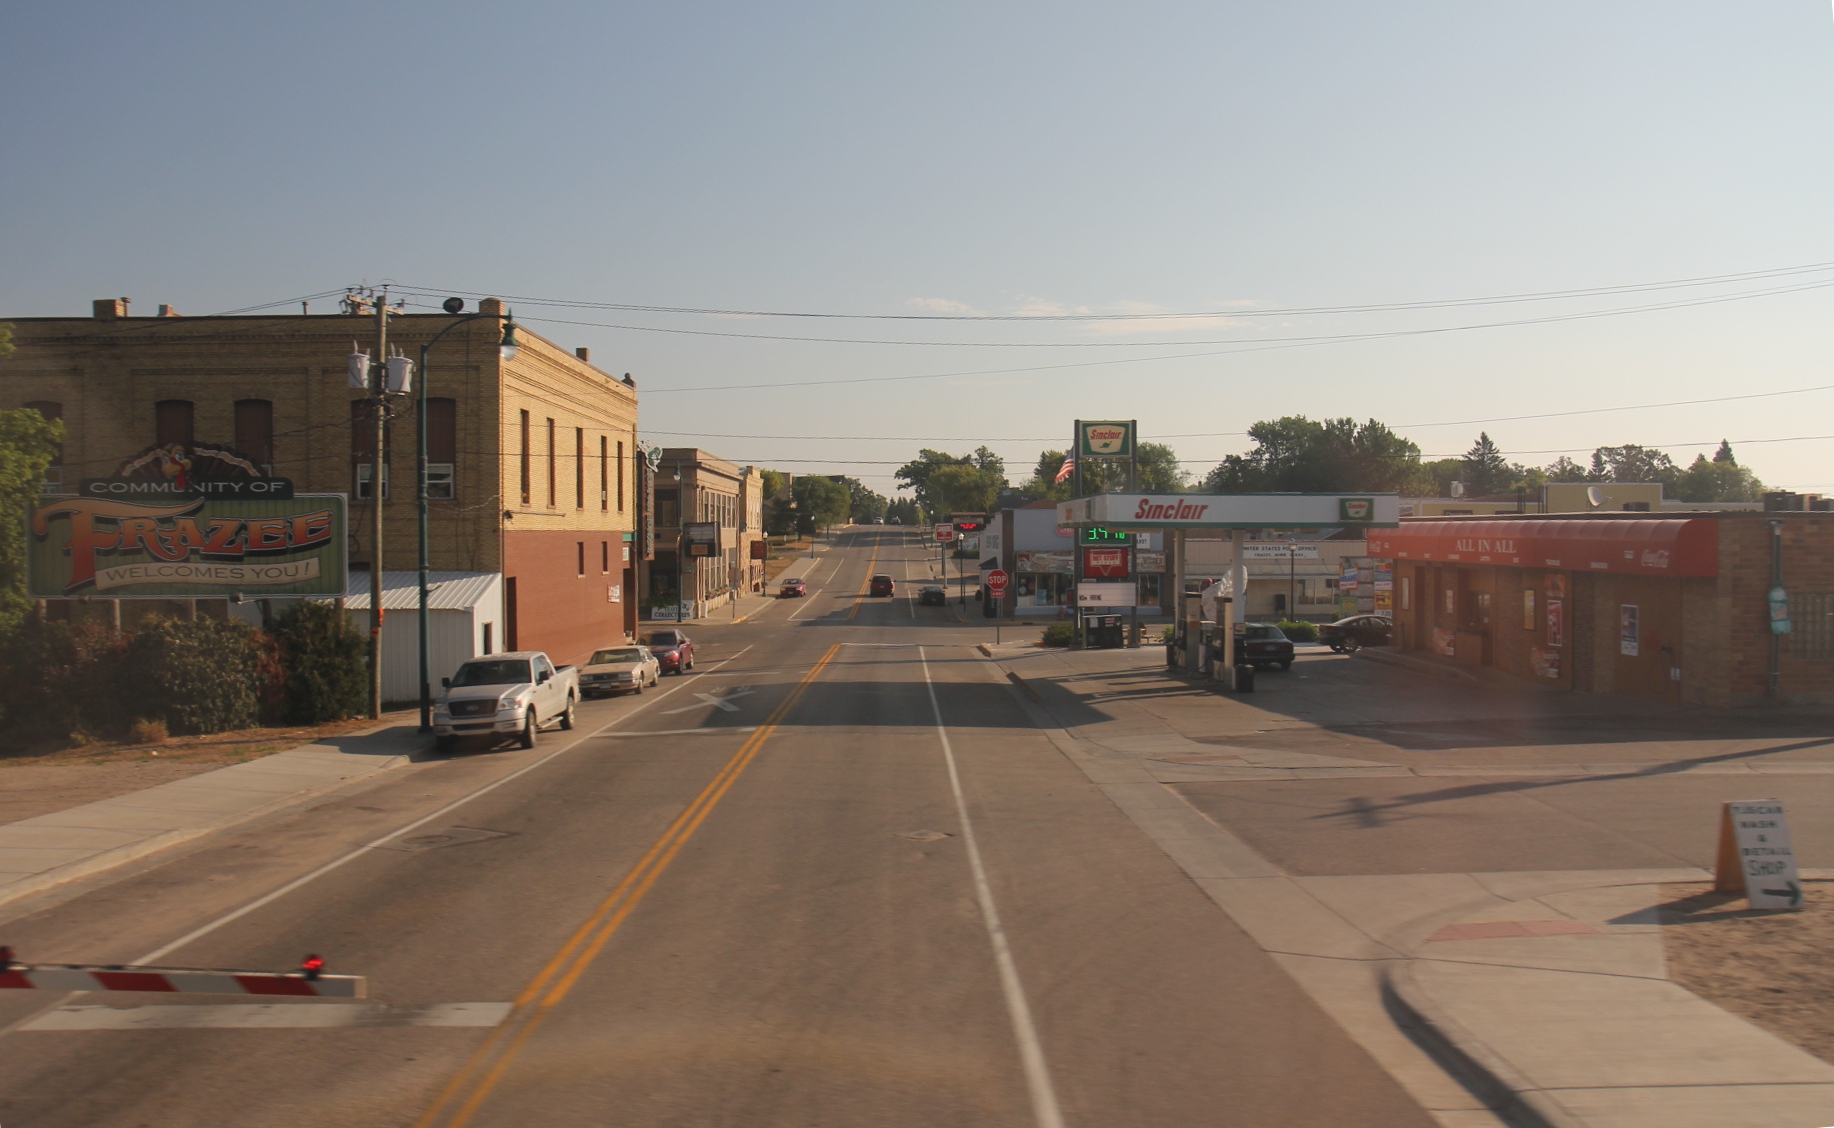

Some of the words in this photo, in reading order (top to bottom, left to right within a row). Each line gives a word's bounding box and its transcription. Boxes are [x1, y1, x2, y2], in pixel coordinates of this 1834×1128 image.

[1090, 429, 1122, 440] Sinclair
[89, 481, 243, 494] COMMUNITY
[250, 481, 286, 494] OF
[1134, 498, 1209, 520] Sinclair
[33, 496, 334, 592] FRAZEE
[1456, 539, 1475, 552] ALL
[1478, 539, 1491, 552] IN
[1494, 540, 1516, 553] ALL
[106, 565, 245, 582] WELCOMES
[250, 561, 311, 580] YOU!
[988, 576, 1007, 584] STOP
